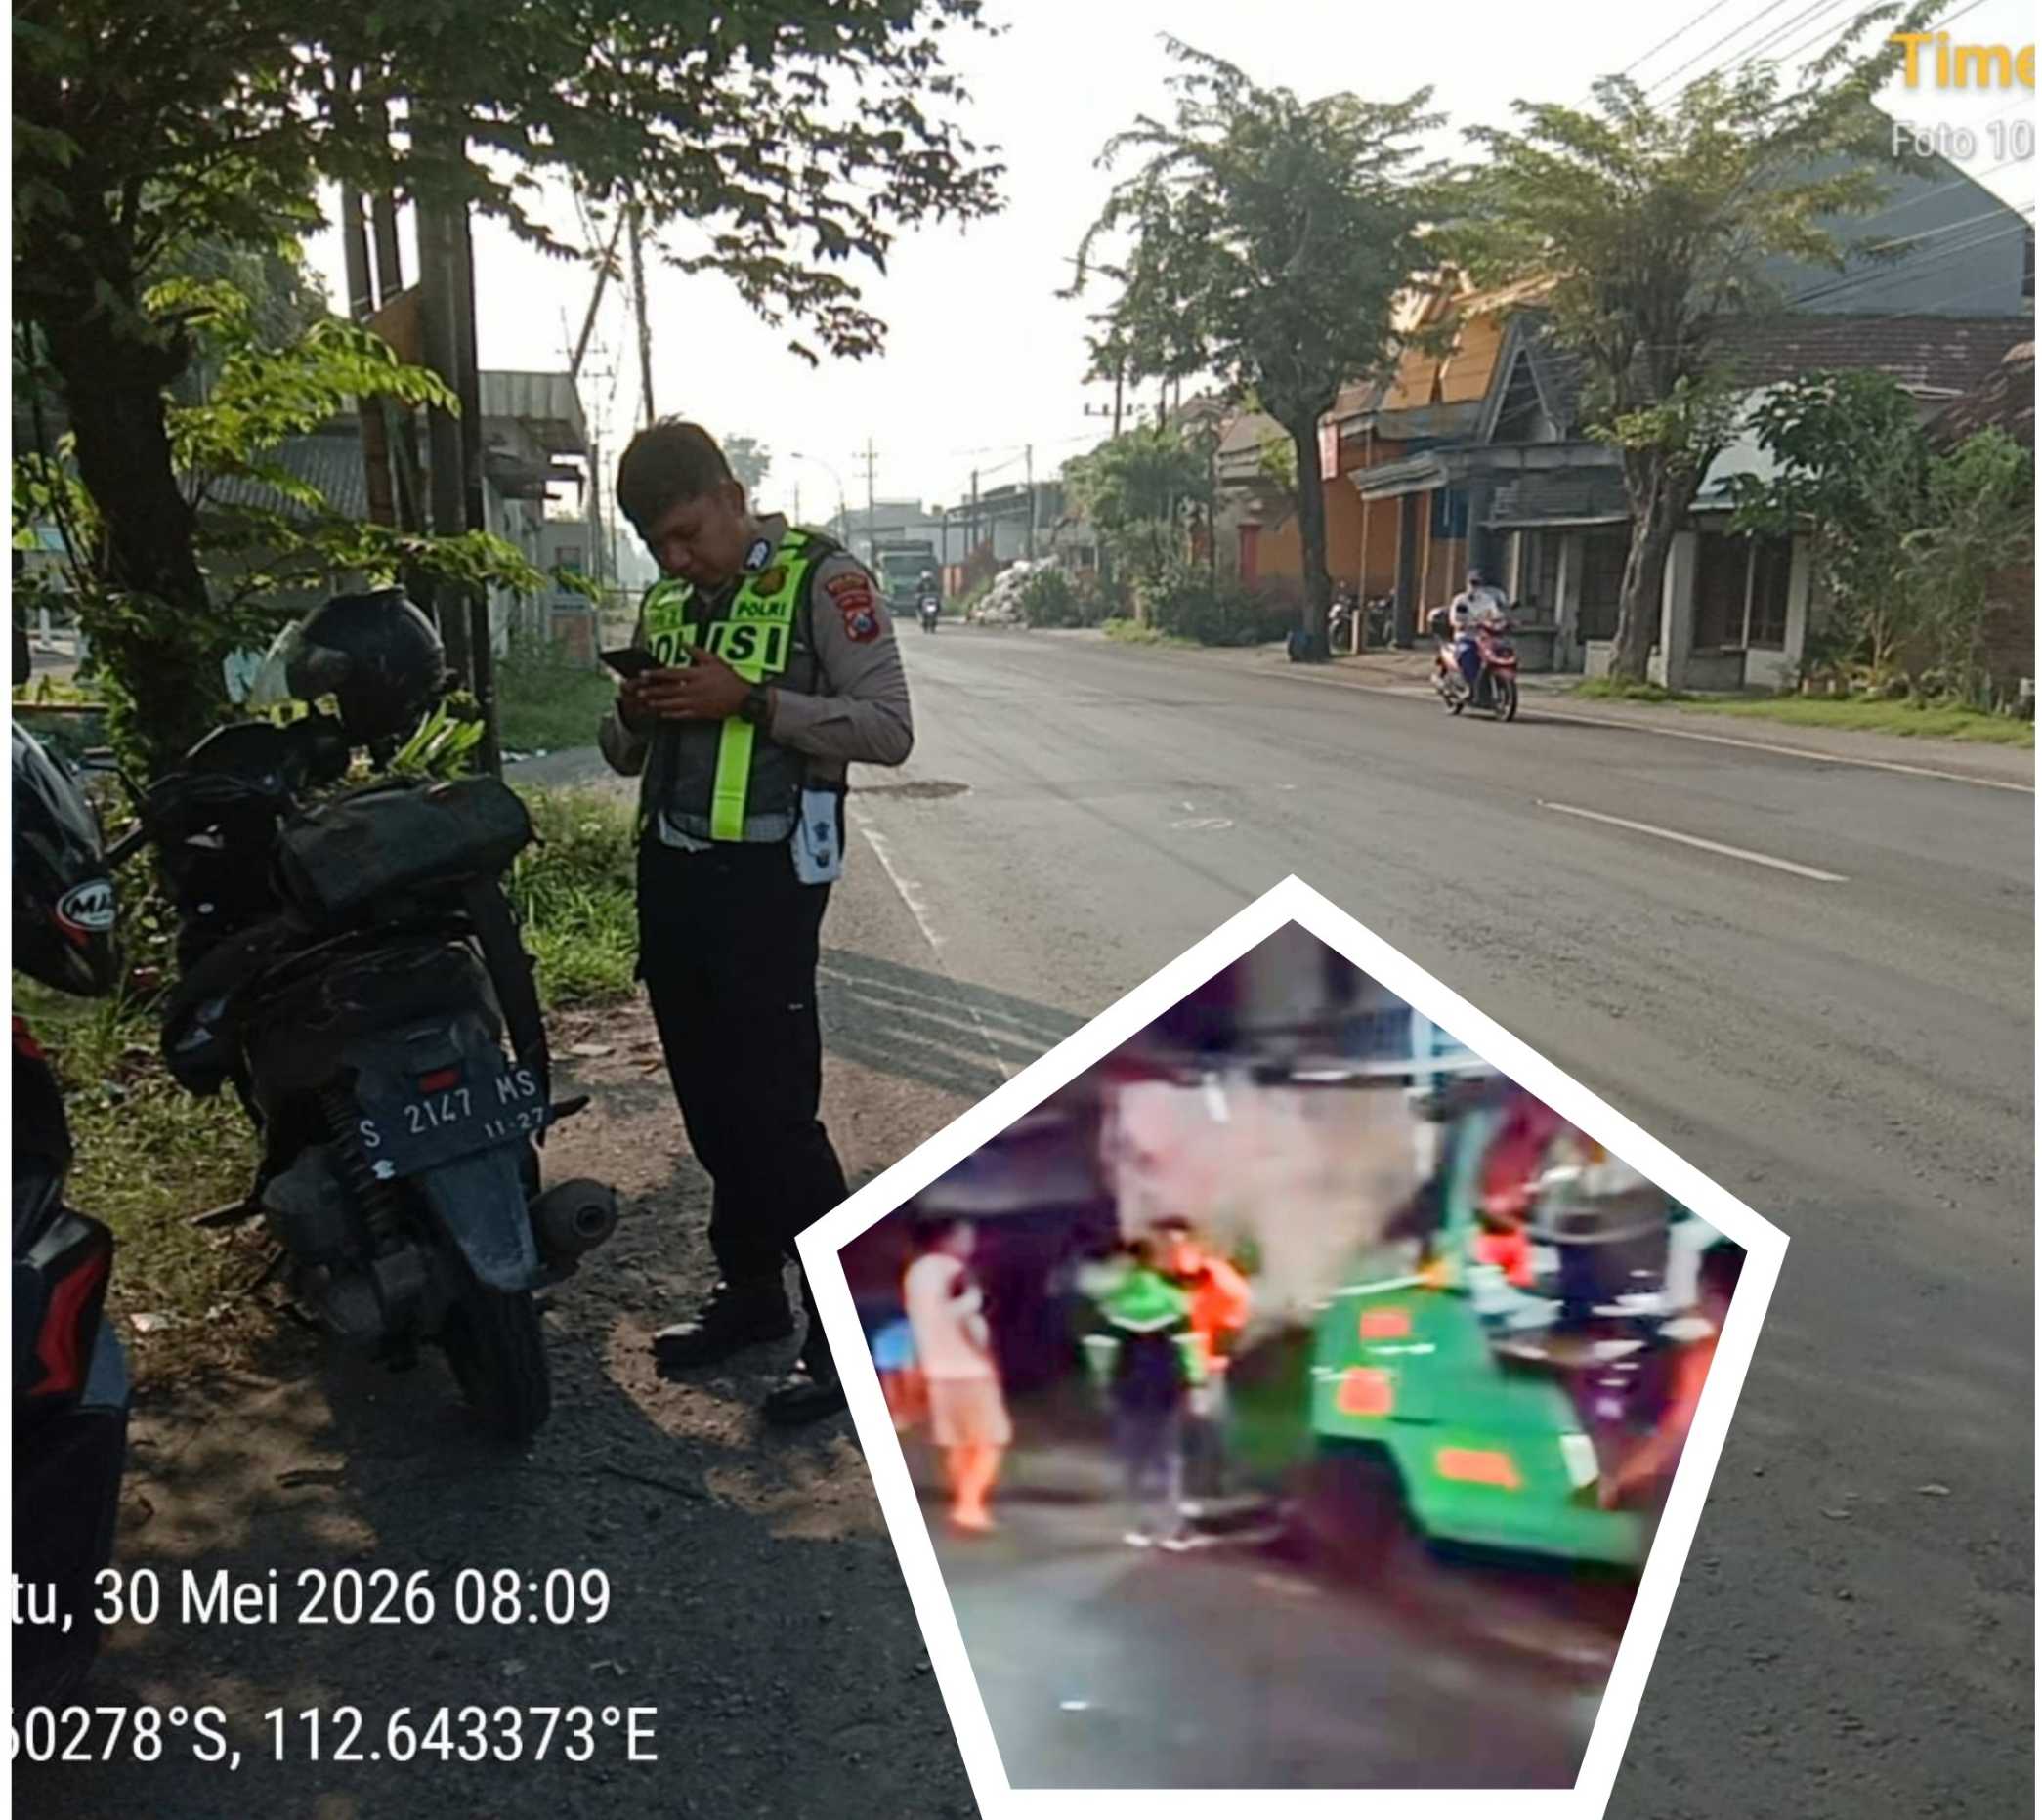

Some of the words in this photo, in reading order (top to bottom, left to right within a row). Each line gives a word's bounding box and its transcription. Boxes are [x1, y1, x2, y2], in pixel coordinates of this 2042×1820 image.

[737, 601, 787, 617] POLRI
[648, 625, 781, 666] OLISI
[359, 1119, 381, 1148] S
[403, 1087, 472, 1134] 2147
[495, 1070, 537, 1105] MS
